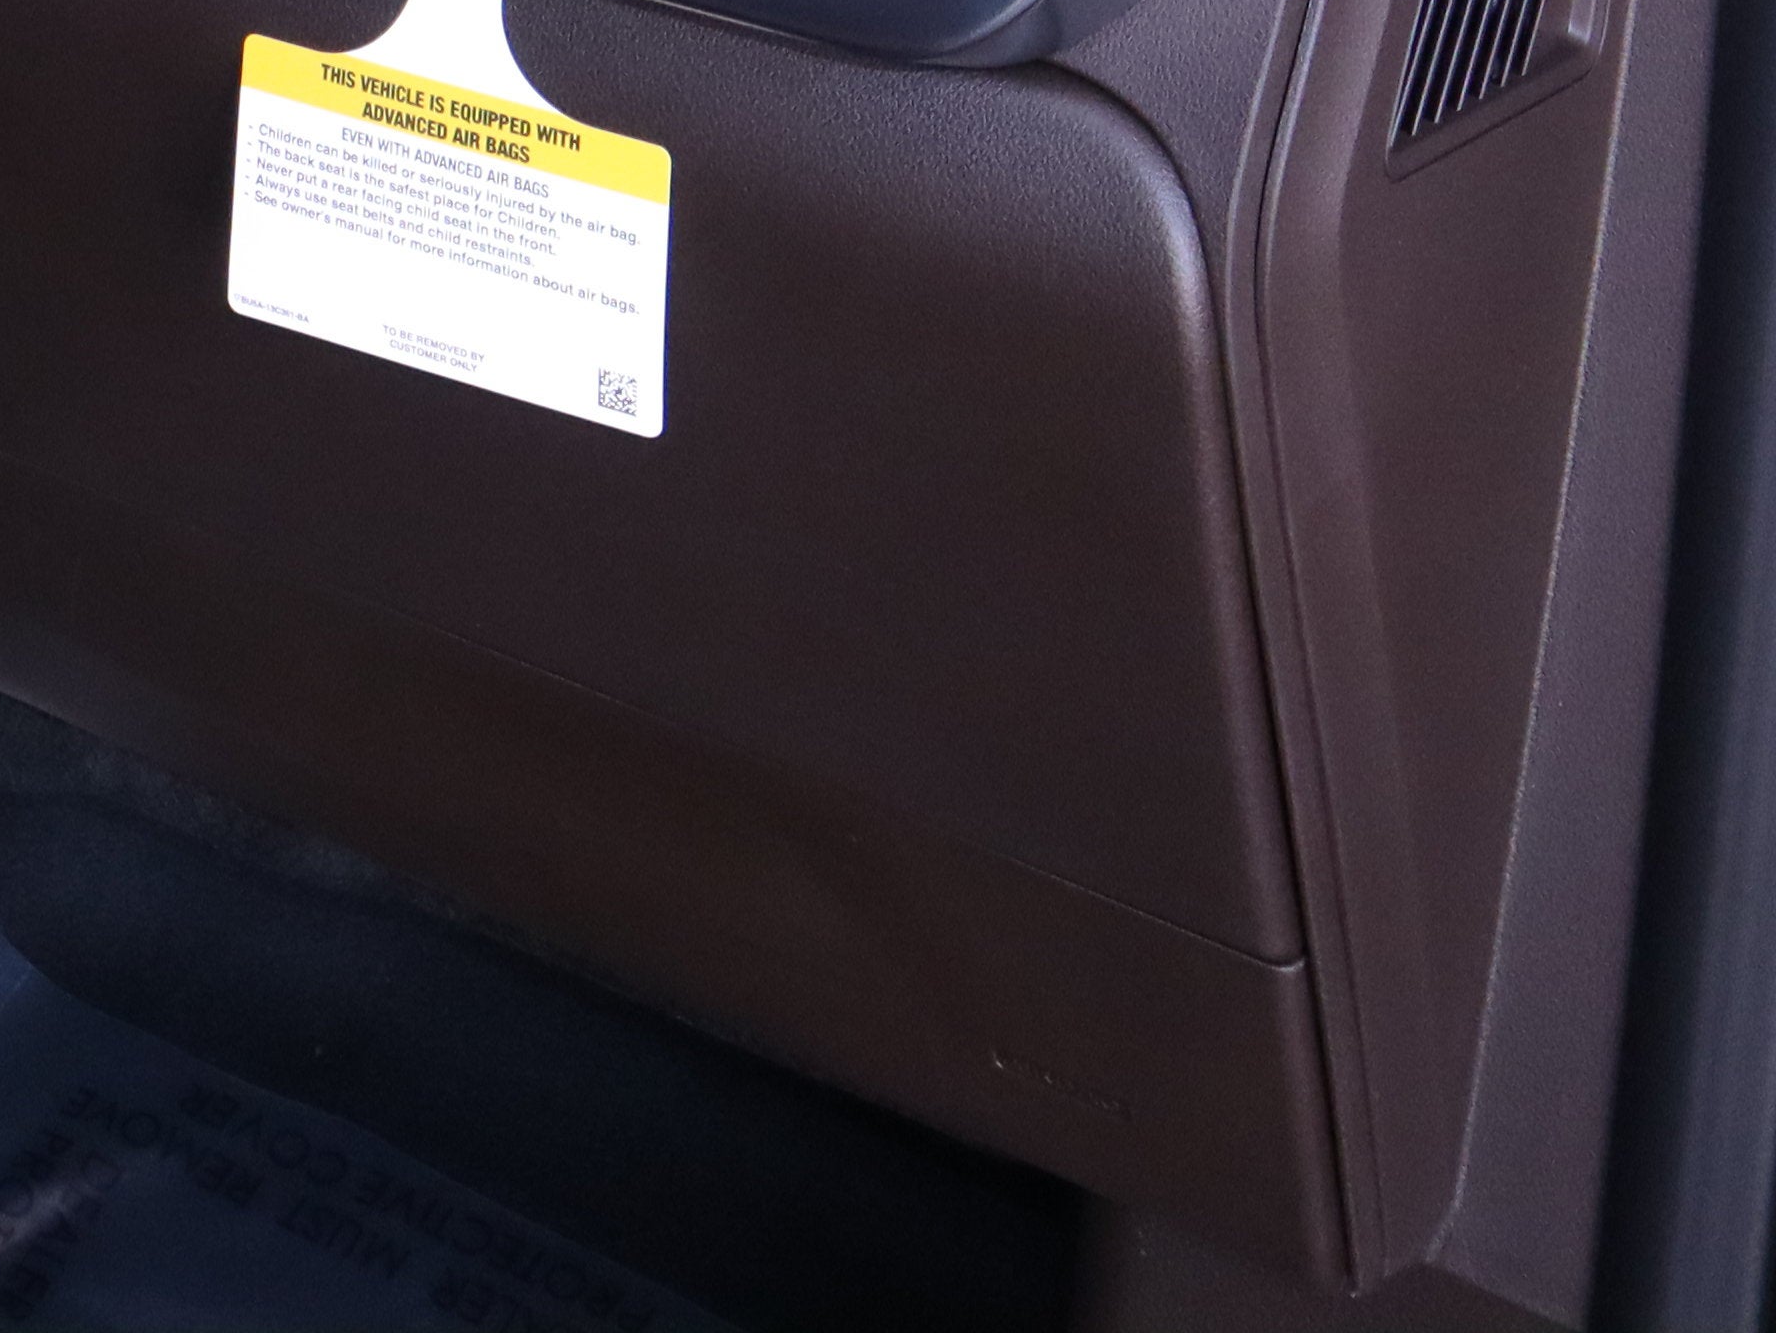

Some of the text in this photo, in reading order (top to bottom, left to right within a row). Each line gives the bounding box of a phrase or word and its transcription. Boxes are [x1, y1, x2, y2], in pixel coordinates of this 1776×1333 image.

[321, 63, 581, 151] THIS VEHICLE IS EQUIPPED WITH
[362, 102, 531, 163] ADVANCED AIR BAGS
[257, 140, 561, 240] The back seat is the safest place for Children.
[257, 157, 293, 177] Never
[297, 171, 317, 187] put
[332, 182, 358, 197] rear
[362, 189, 402, 213] facing
[406, 204, 440, 221] child
[444, 214, 473, 231] seat
[476, 222, 490, 237] in
[493, 227, 515, 244] the
[519, 234, 557, 256] front.
[259, 123, 640, 246] Children can be killed or seriously injured by the air bag.
[341, 127, 549, 198] EVEN WITH ADVANCED AIR BAGS
[254, 190, 640, 315] See owner's manual for more information about air bags.
[255, 174, 535, 268] Always use seat belts and child restraints.
[383, 324, 485, 363] TO BE REMOVED BY
[389, 338, 477, 373] CUSTOMER ONLY
[60, 1084, 265, 1208] REMOVE
[177, 1082, 658, 1333] PROTECTIVE COVER
[275, 1197, 411, 1281] MUST
